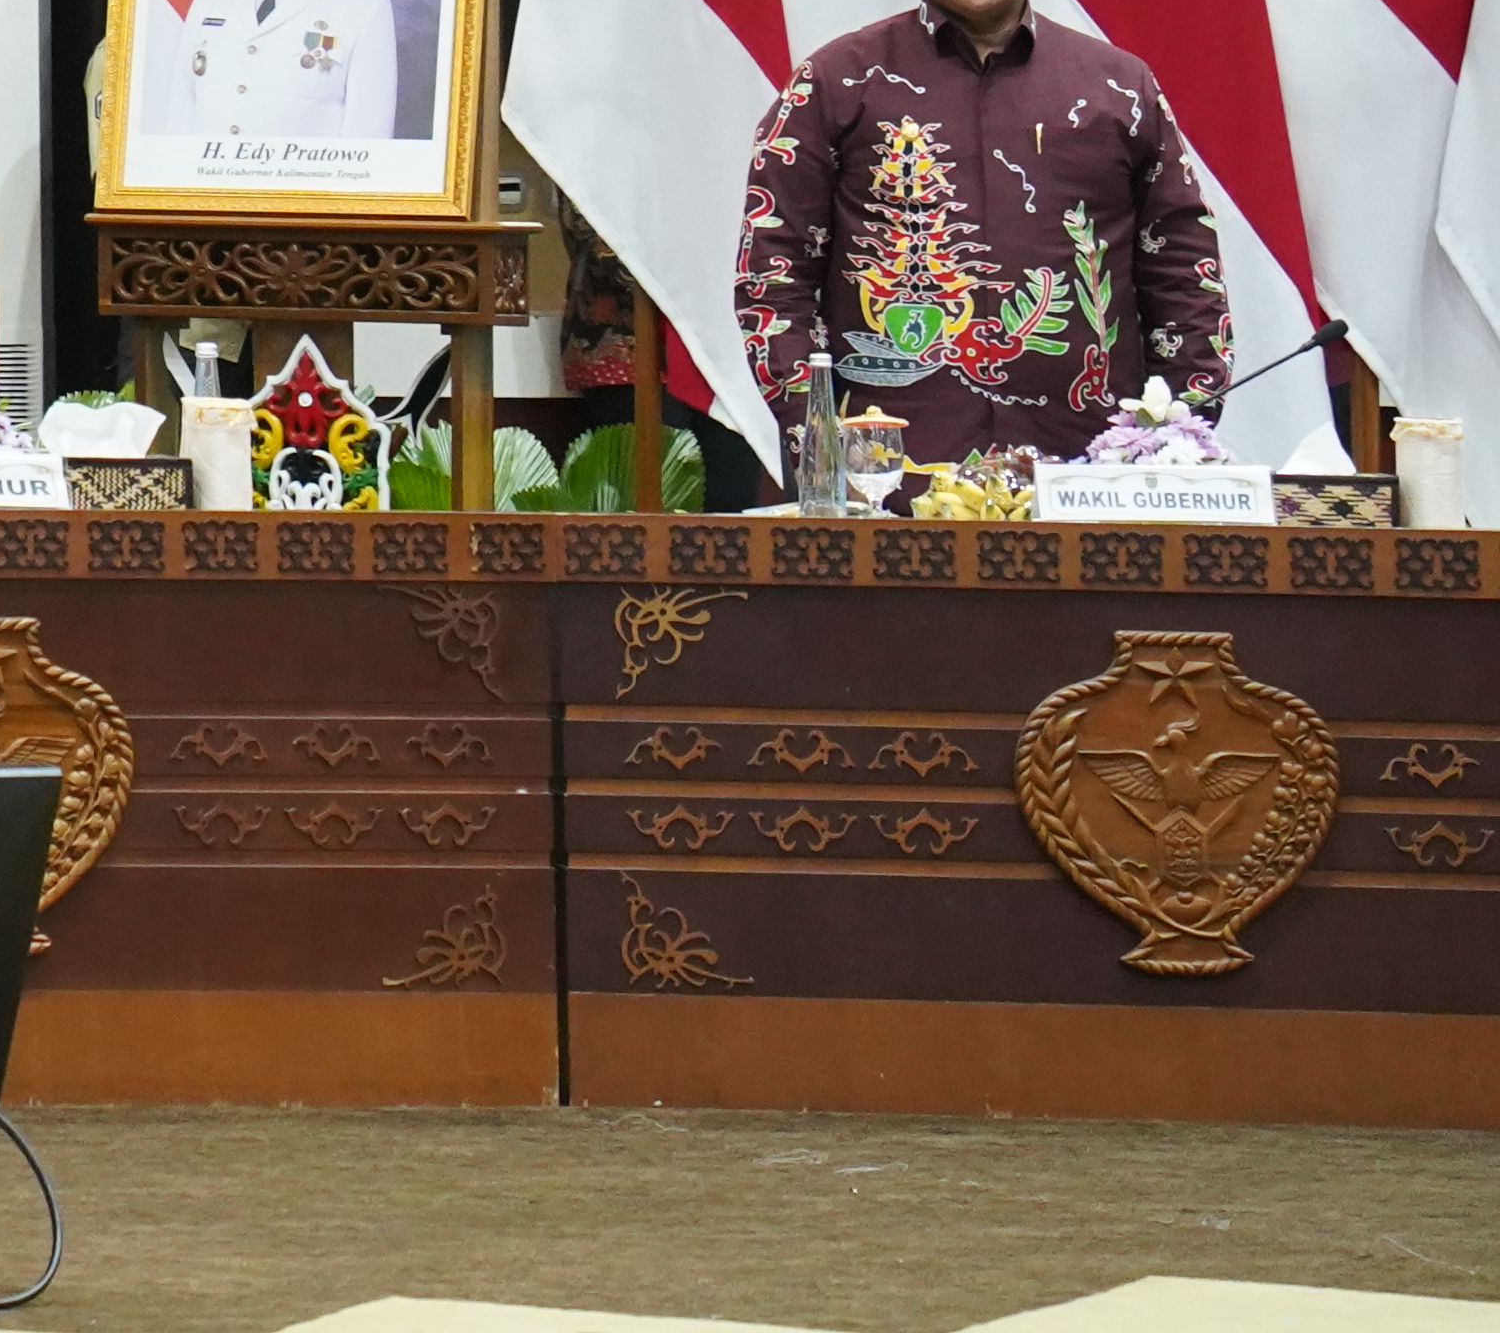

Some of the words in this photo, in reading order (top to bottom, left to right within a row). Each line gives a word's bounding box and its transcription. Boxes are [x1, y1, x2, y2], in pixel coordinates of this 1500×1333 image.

[202, 141, 226, 160] H.
[234, 143, 276, 164] Edy
[282, 143, 369, 164] Pratowo
[197, 167, 223, 177] Wakil
[226, 167, 274, 178] Gubernur
[276, 168, 333, 179] Kalimantan
[336, 169, 371, 181] Tengah
[1056, 489, 1126, 509] WAKIL
[1132, 490, 1252, 511] GUBERNUR
